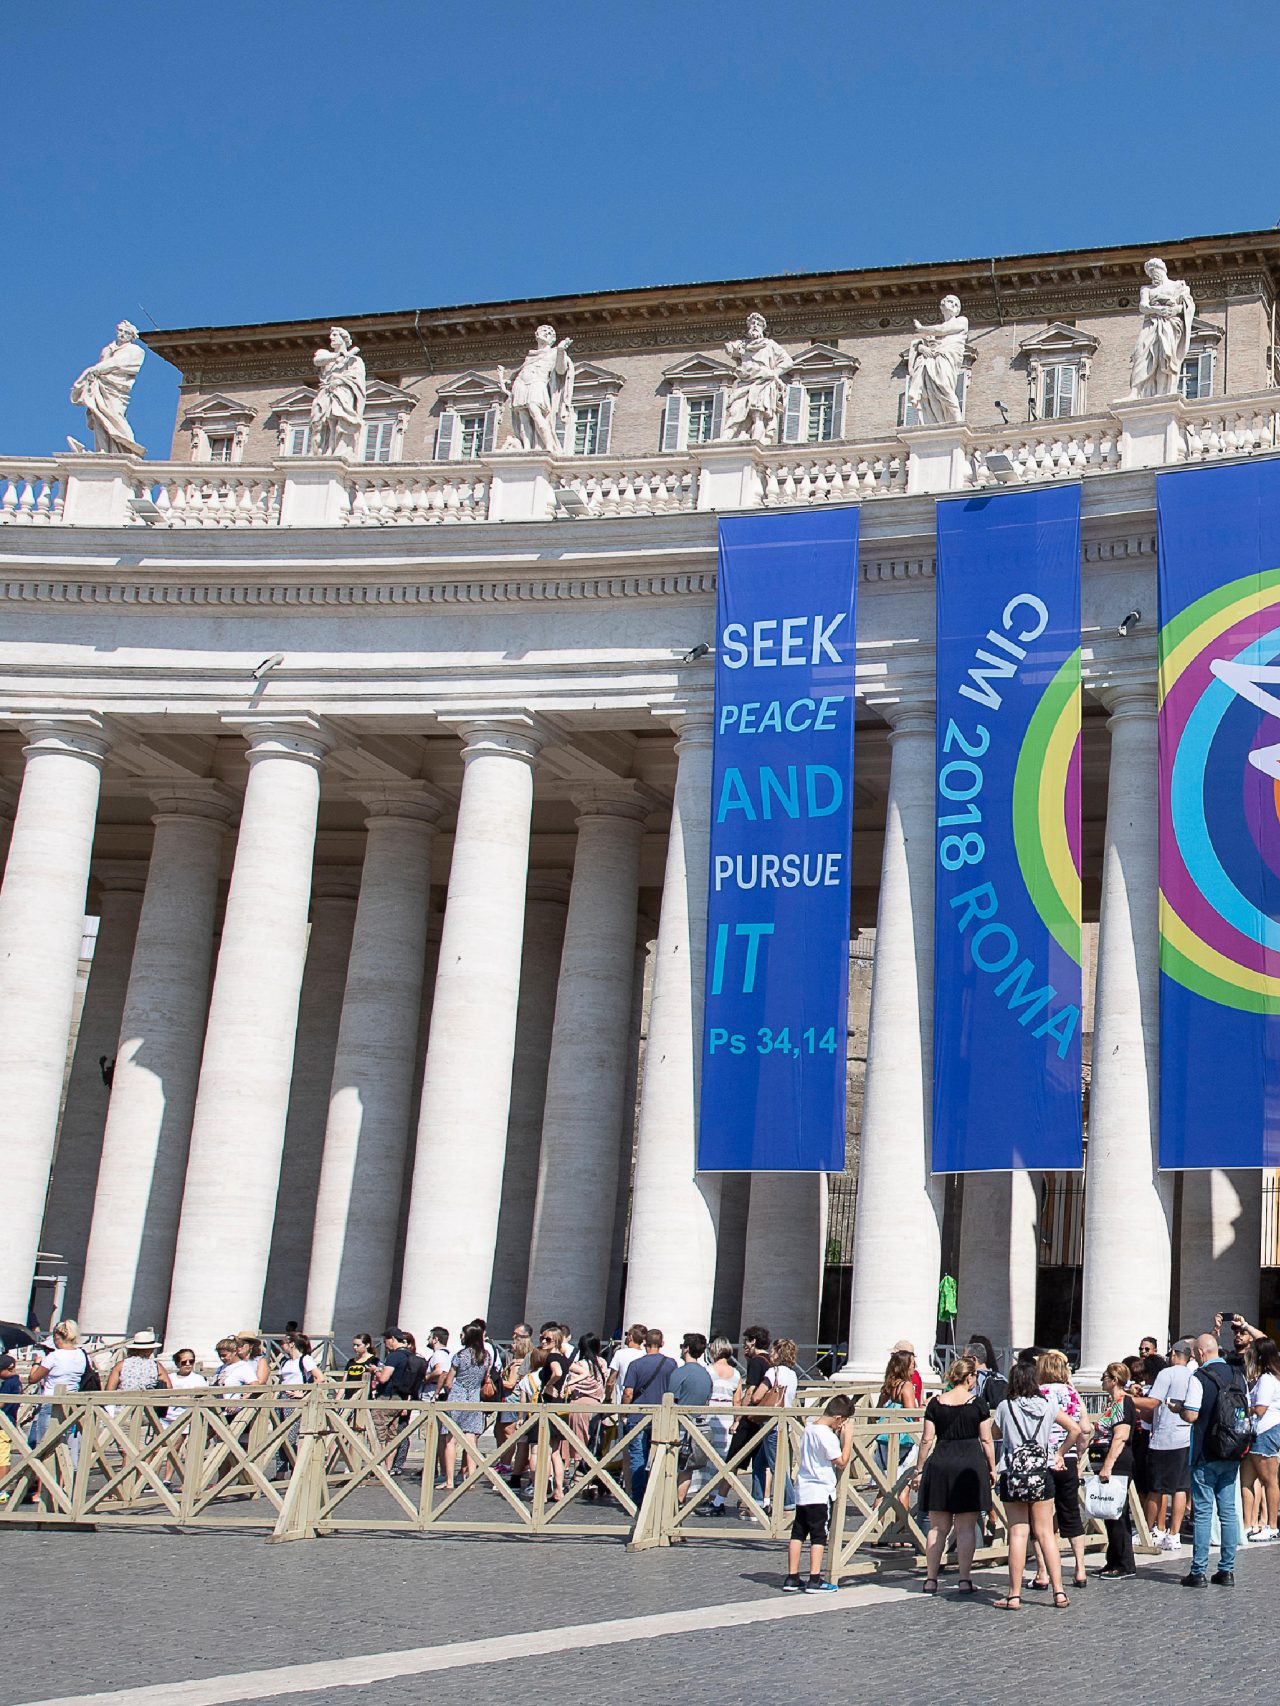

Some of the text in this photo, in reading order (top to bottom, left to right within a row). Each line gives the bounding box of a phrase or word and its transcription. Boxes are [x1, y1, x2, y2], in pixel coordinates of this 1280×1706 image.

[722, 612, 847, 669] SEEK
[719, 695, 845, 735] PEACE
[716, 764, 843, 824] AND
[938, 593, 1081, 1060] CIM 2018 ROMA
[714, 852, 841, 892] PURSUE
[711, 923, 775, 995] IT
[709, 1025, 838, 1060] Ps 34,14
